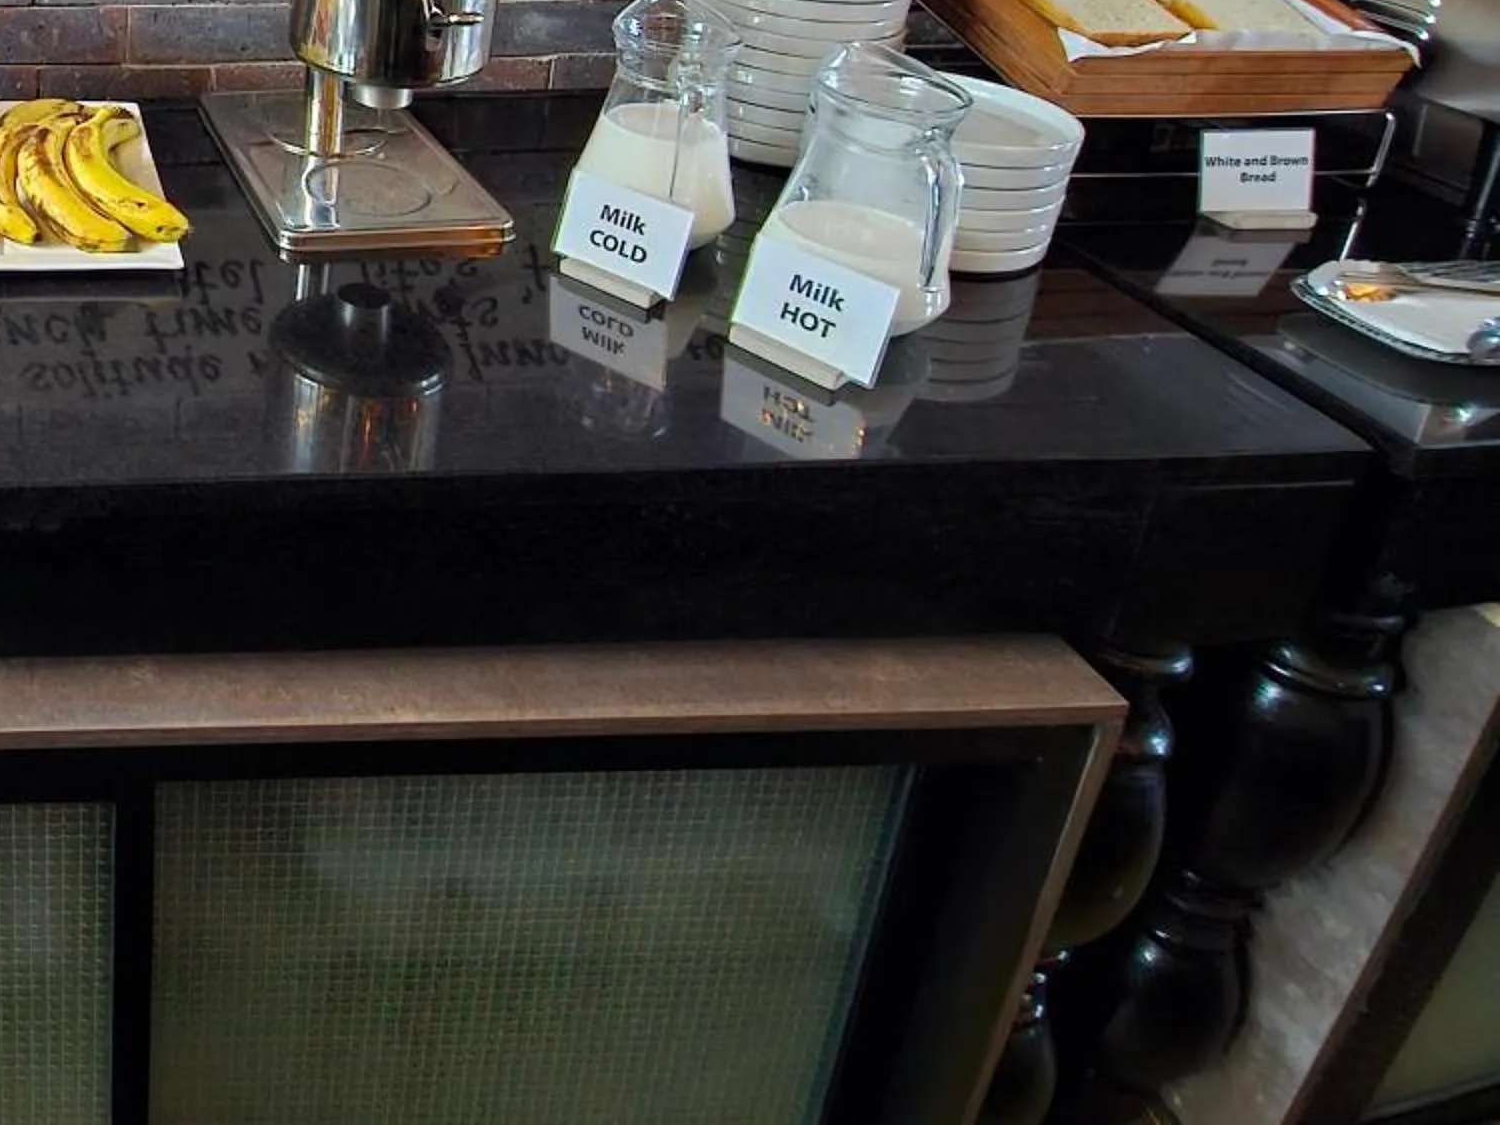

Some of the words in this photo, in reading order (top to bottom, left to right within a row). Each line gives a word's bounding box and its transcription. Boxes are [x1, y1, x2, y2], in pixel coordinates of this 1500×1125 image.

[1204, 156, 1241, 168] White
[1243, 155, 1268, 167] and
[1269, 155, 1309, 167] Brown
[1239, 171, 1277, 183] Bread
[599, 203, 647, 236] Milk
[589, 229, 648, 264] COLD
[788, 273, 845, 312] Milk
[779, 301, 837, 338] HOT
